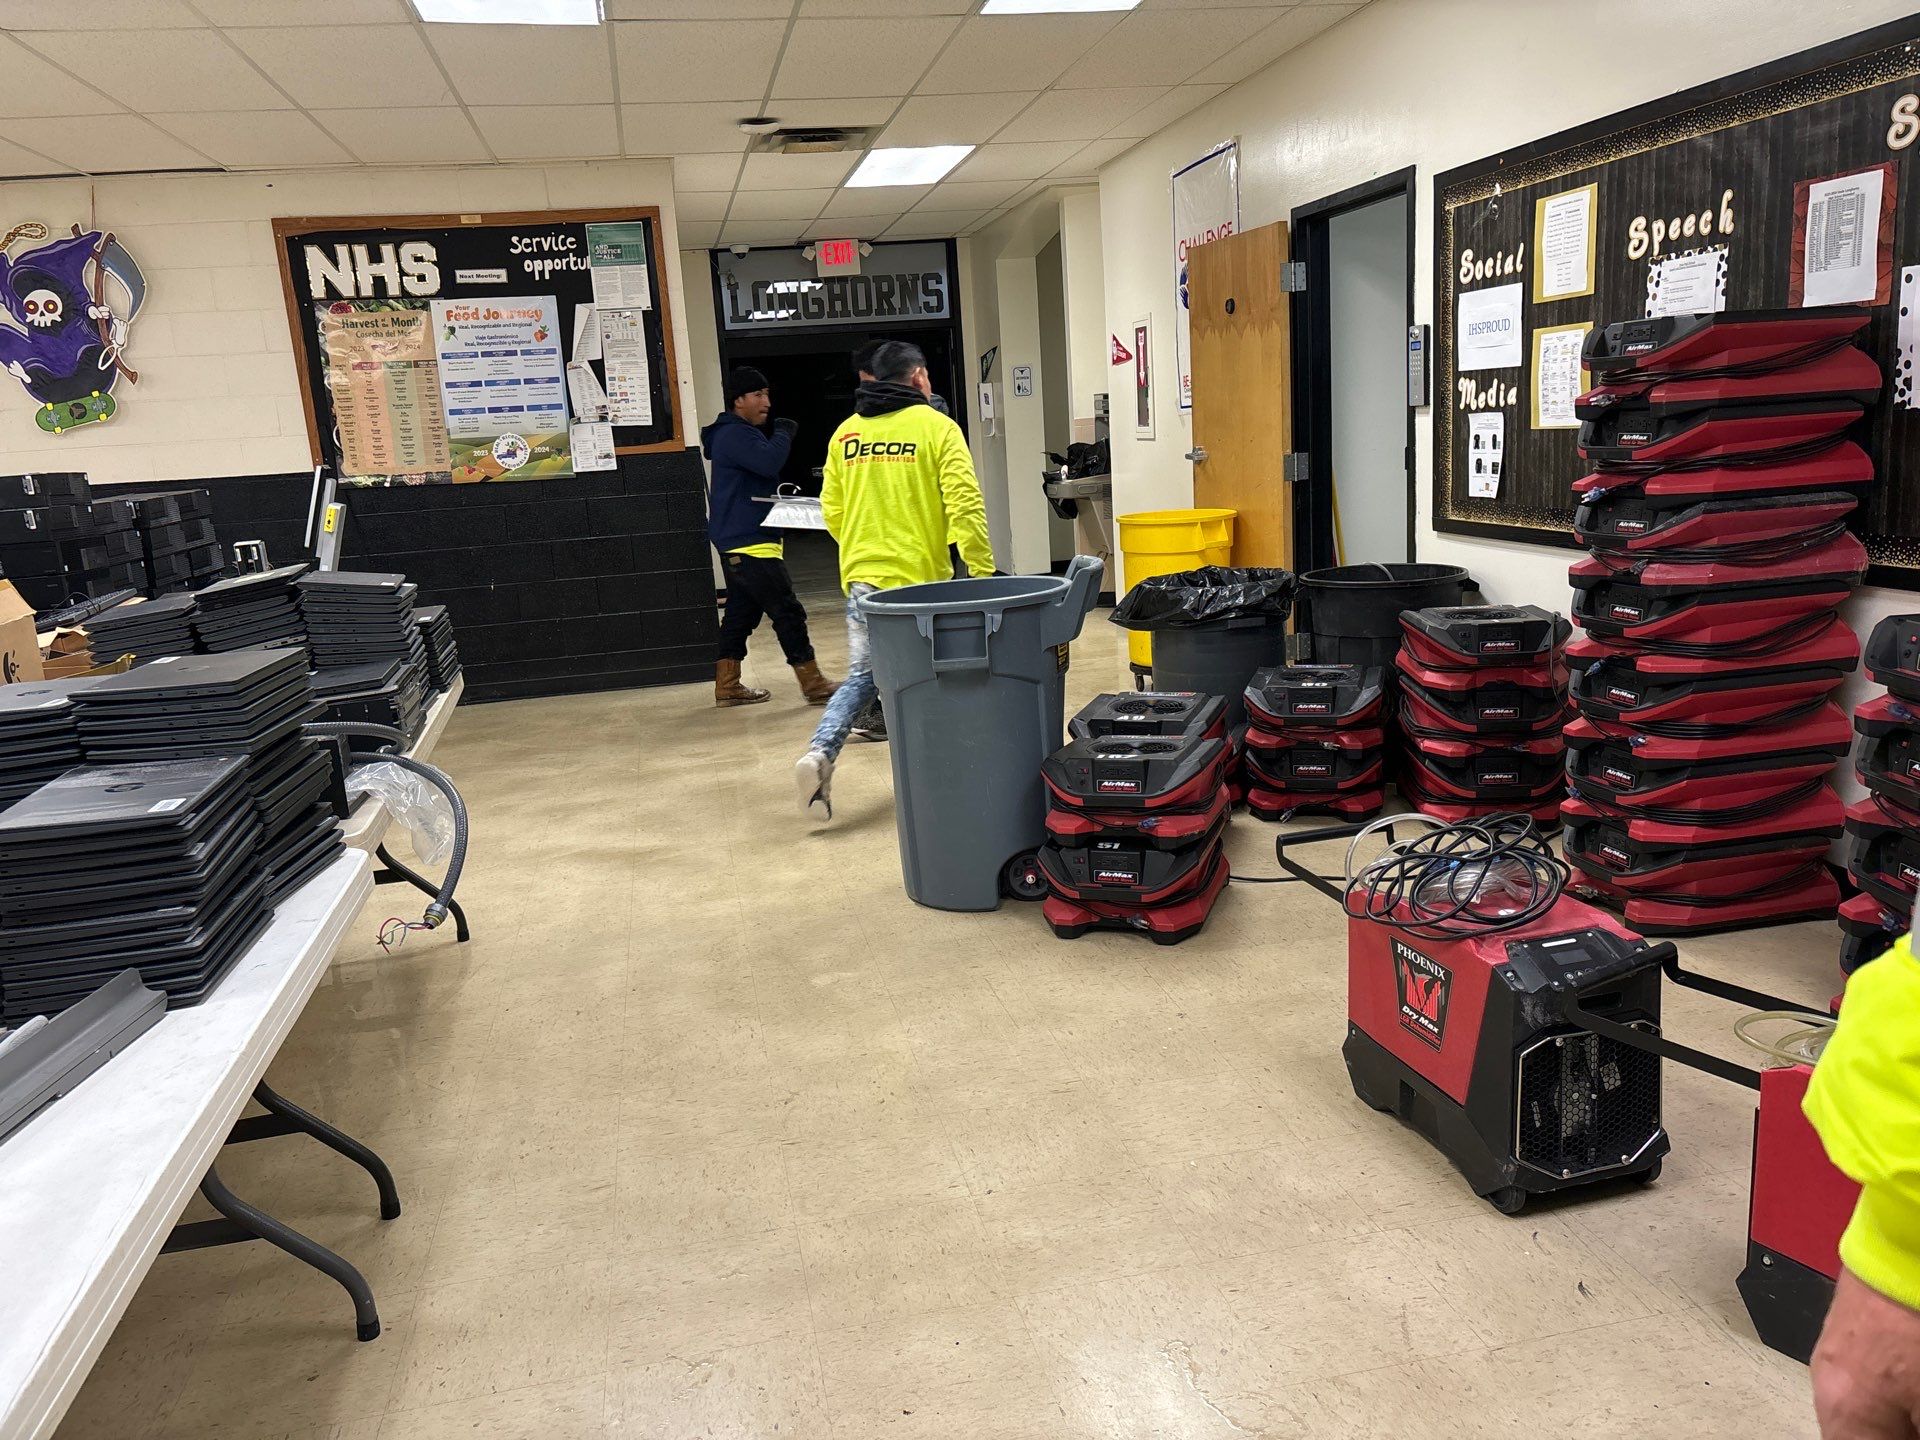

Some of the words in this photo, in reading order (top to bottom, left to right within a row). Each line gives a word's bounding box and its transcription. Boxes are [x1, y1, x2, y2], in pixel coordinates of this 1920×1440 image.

[1628, 188, 1735, 260] Speech
[509, 232, 577, 255] Service
[823, 241, 853, 265] EXIT
[304, 241, 440, 299] NHS
[1459, 242, 1524, 284] Social
[726, 272, 945, 324] LONGHORNS
[341, 318, 380, 329] Harvest
[391, 316, 422, 328] Month
[445, 307, 480, 322] Food
[483, 307, 543, 323] Journey
[355, 329, 383, 338] Cosecha
[386, 329, 396, 337] del
[471, 323, 502, 331] Recognizable
[512, 321, 533, 329] Regional
[1468, 318, 1511, 336] IHSPROUD
[350, 345, 365, 353] 2023
[1626, 344, 1654, 352] AirMax
[1459, 376, 1518, 411] Media
[844, 438, 917, 460] DECOR
[1613, 606, 1639, 615] AirMax
[1610, 688, 1636, 699] AirMax
[1606, 769, 1632, 780] AirMax
[1603, 846, 1628, 860] AirMax
[1098, 871, 1134, 879] AirMax
[1397, 942, 1446, 981] PHOENIX
[1402, 1005, 1419, 1020] Dry
[1419, 1016, 1440, 1034] Max
